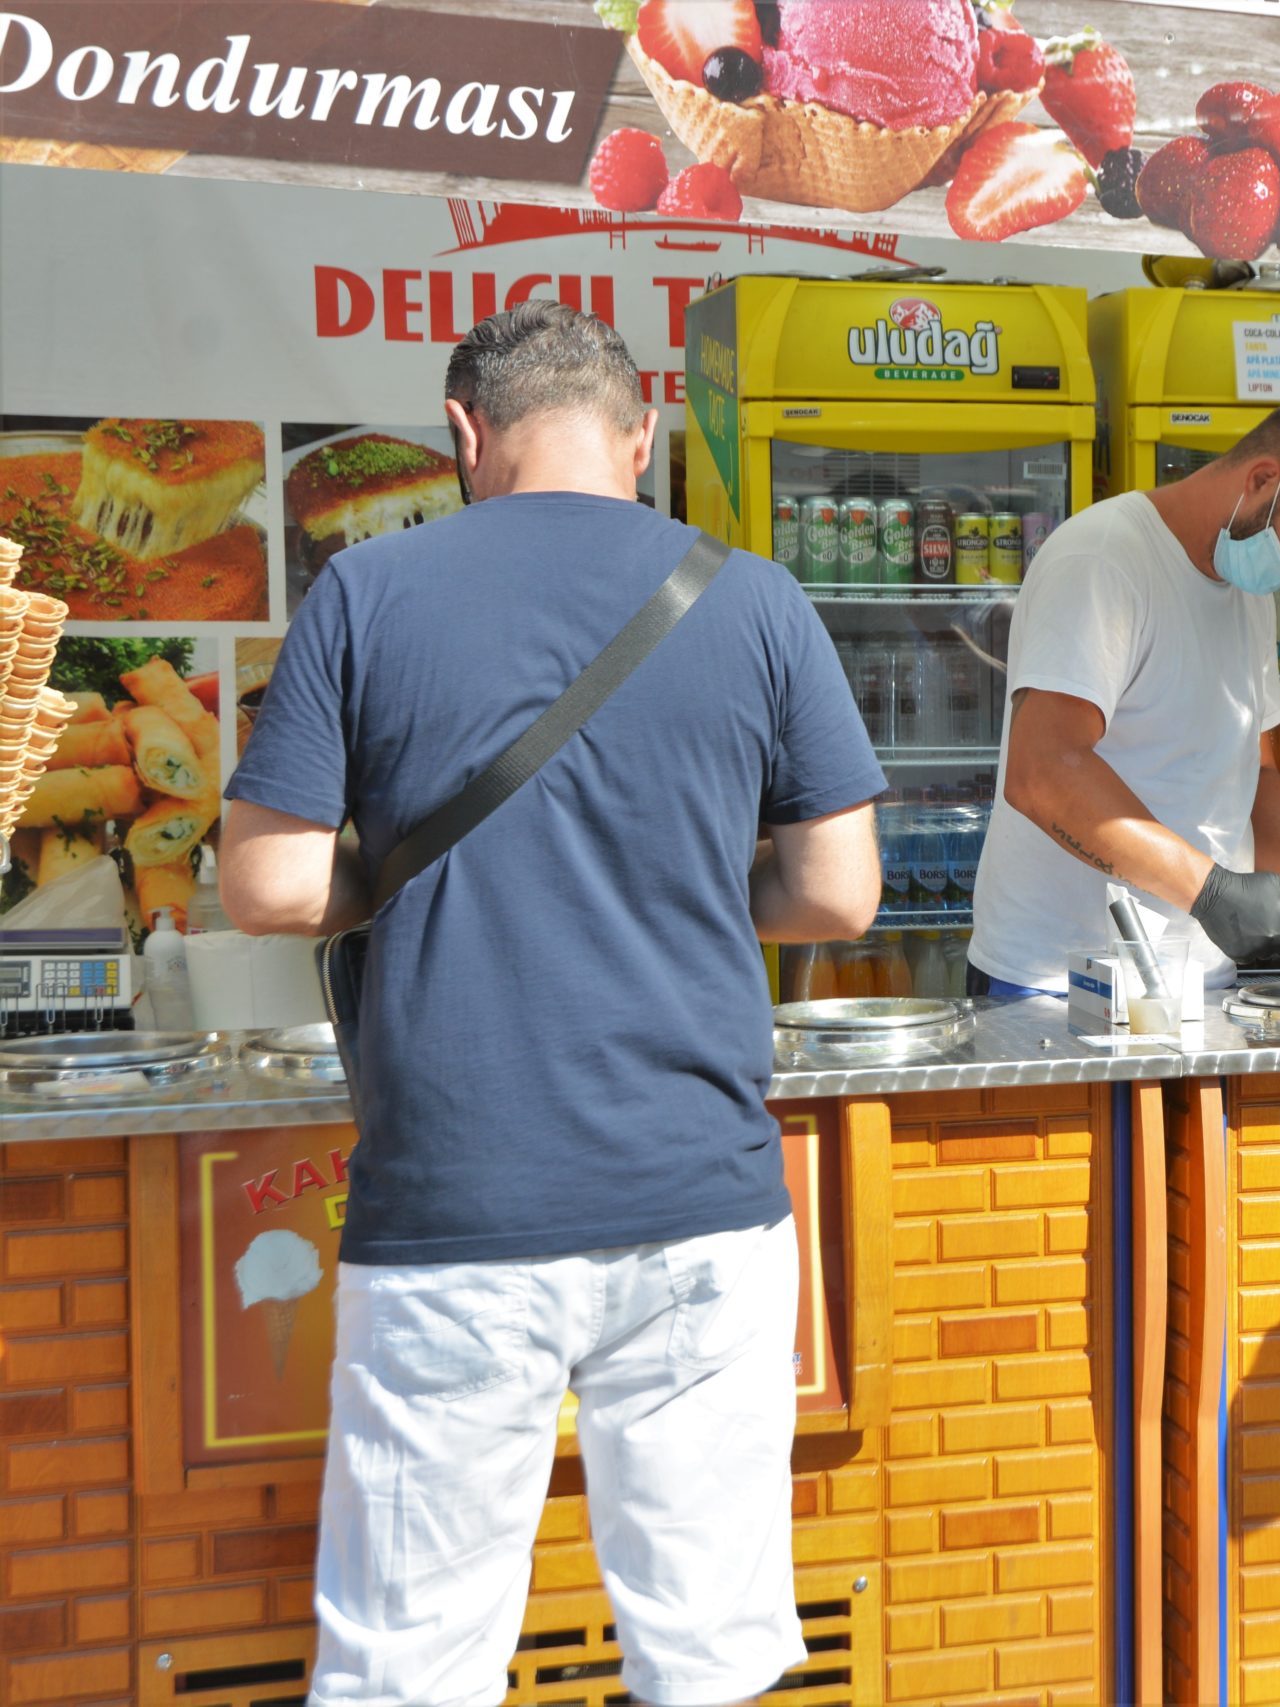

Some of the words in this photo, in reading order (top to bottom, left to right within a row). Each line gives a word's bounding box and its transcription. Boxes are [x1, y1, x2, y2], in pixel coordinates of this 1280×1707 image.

[848, 319, 1000, 376] uludağ
[883, 369, 957, 380] BEVERAGE
[1248, 383, 1273, 393] LIPTON
[924, 544, 949, 555] SILVA
